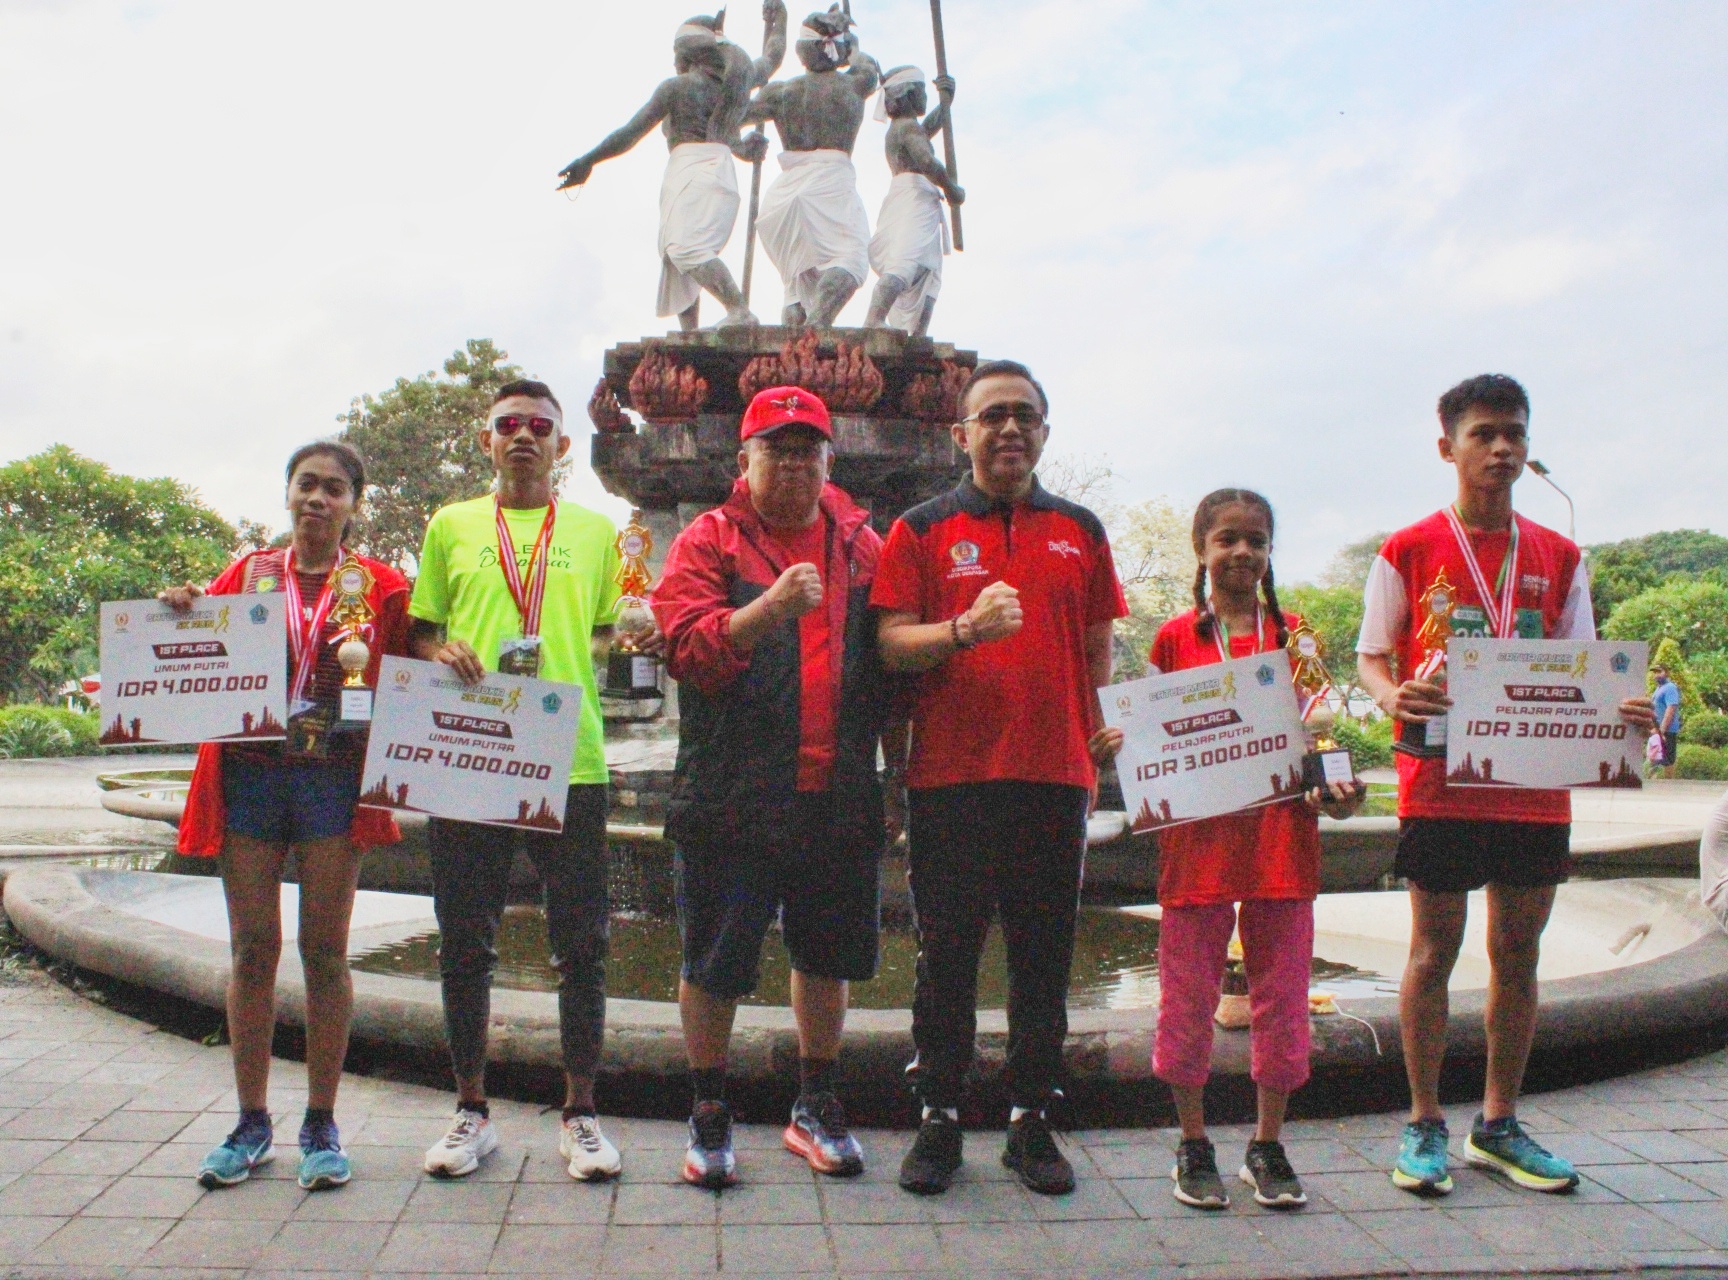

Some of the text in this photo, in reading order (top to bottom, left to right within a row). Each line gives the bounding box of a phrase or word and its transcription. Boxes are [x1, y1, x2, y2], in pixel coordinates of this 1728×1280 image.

[160, 643, 219, 654] 1ST PLACE
[154, 661, 229, 673] UMUM PUTRI
[117, 674, 269, 698] IDR 4.000.000
[1512, 688, 1576, 698] 1ST PLACE
[1495, 705, 1598, 717] PELAJAR PUTRA
[440, 715, 506, 732] 1ST PLACE
[1171, 711, 1232, 732] 1ST PLACE
[1466, 720, 1511, 737] IDR
[1516, 721, 1627, 740] 3.000.000
[428, 733, 515, 753] UMUM PUTRA
[1162, 725, 1254, 753] PELAJAR PUTRI
[385, 743, 552, 780] IDR 4.000.000
[1136, 734, 1288, 781] IDR 3.000.000
